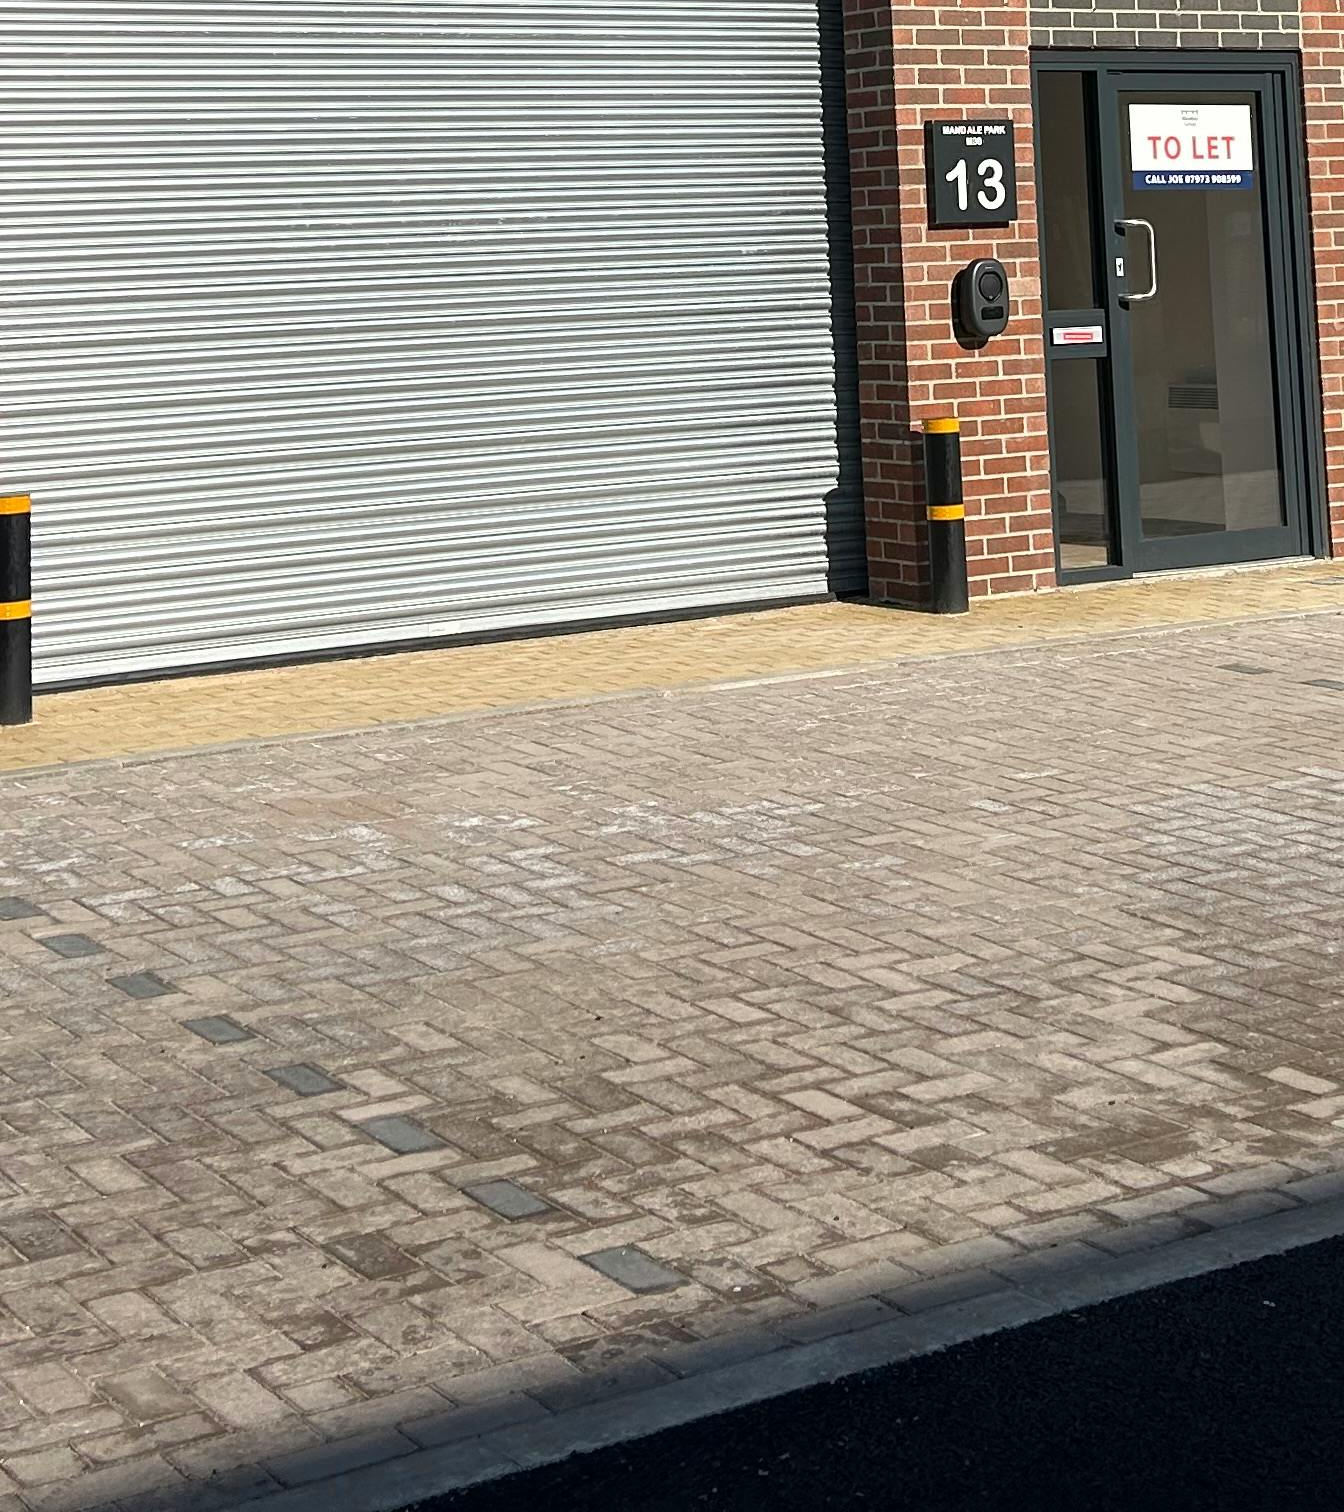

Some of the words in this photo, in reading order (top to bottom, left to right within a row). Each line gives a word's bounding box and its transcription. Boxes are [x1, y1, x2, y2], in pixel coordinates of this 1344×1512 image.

[1147, 135, 1182, 159] TO
[1191, 135, 1235, 159] LET
[945, 158, 1006, 211] 13
[1145, 174, 1167, 184] CALL
[1167, 174, 1184, 184] JOE
